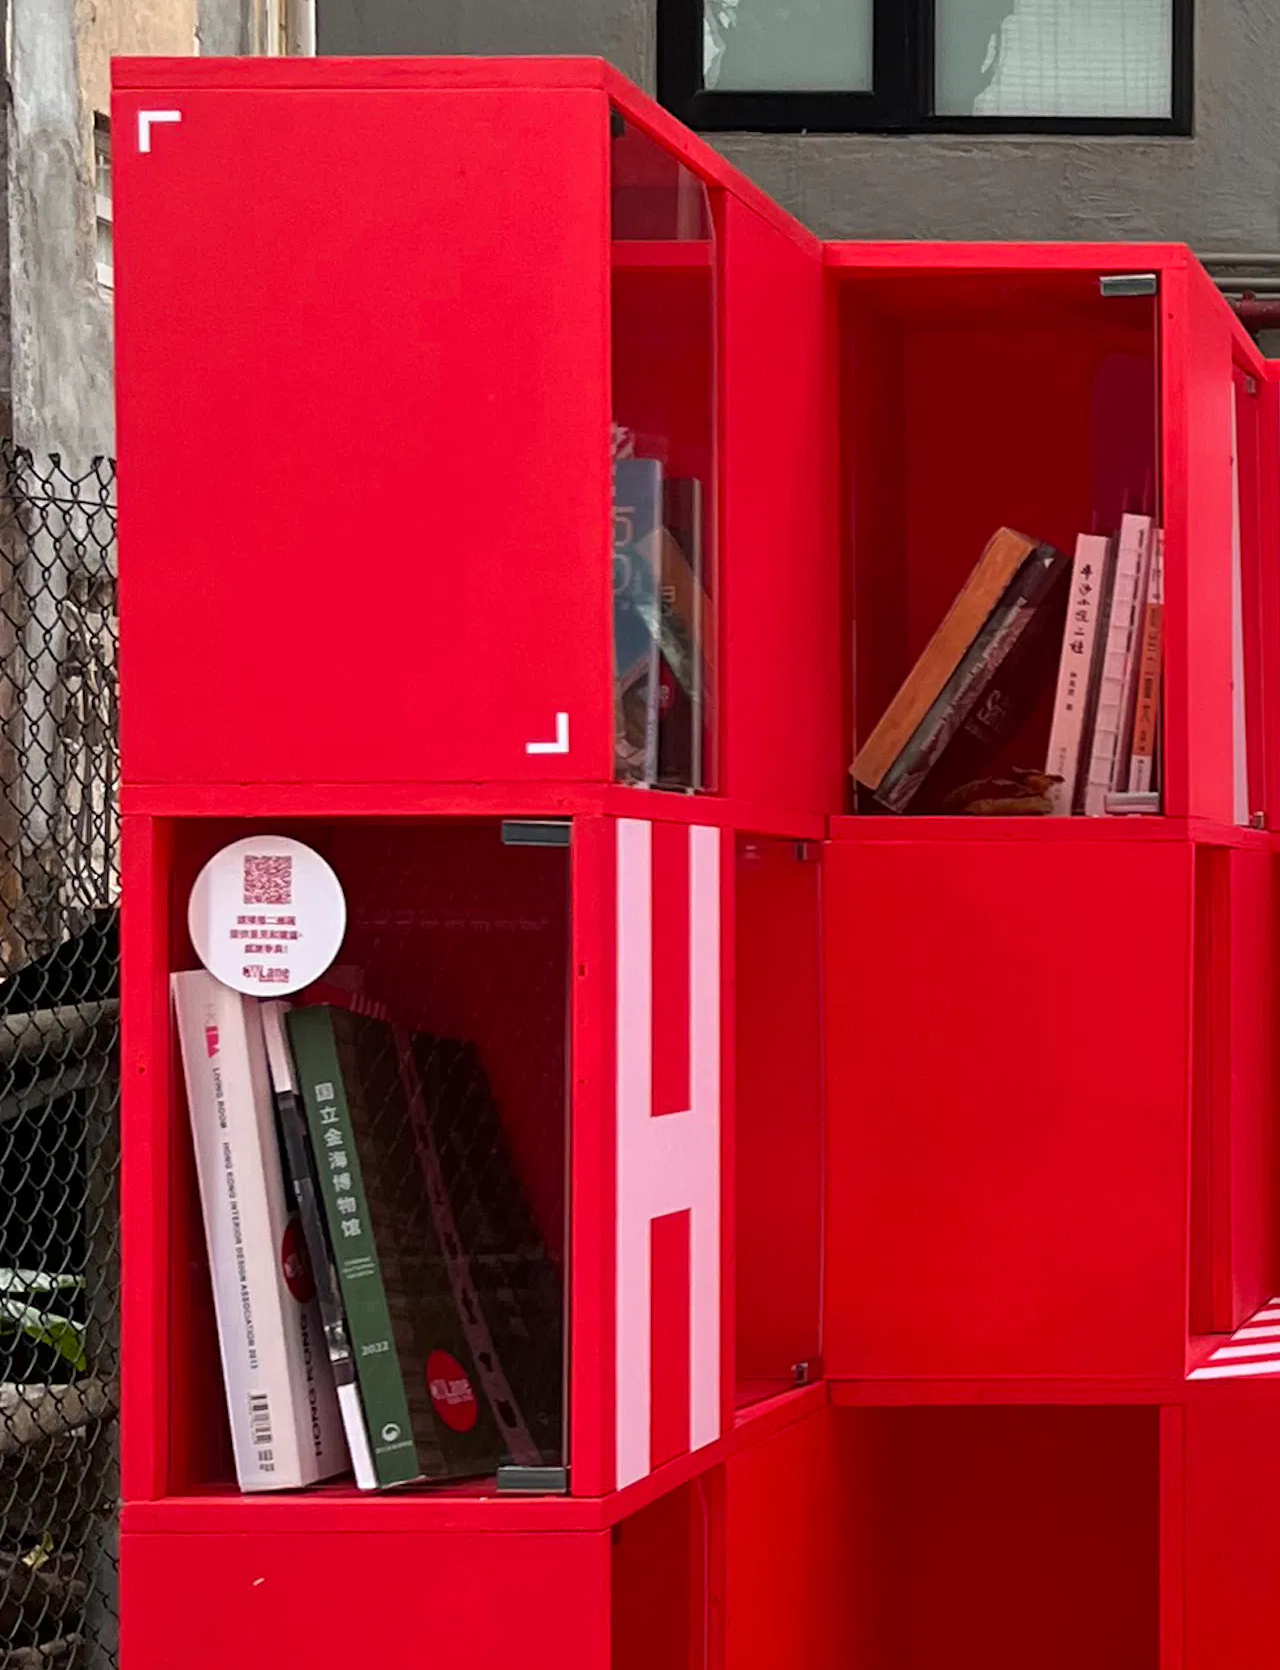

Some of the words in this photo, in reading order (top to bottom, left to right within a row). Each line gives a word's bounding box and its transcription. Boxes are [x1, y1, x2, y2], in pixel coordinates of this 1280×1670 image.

[212, 1067, 224, 1099] LIVING
[217, 1100, 227, 1129] ROOM
[222, 1142, 233, 1169] HONG
[616, 818, 721, 1492] H
[226, 1171, 236, 1198] KONG
[230, 1201, 242, 1245] INTERIOR
[236, 1247, 246, 1282] DESIGN
[240, 1284, 255, 1347] ASSOCIATION
[300, 1313, 314, 1382] KONG
[361, 1341, 389, 1356] 2022
[308, 1387, 323, 1457] HONG
